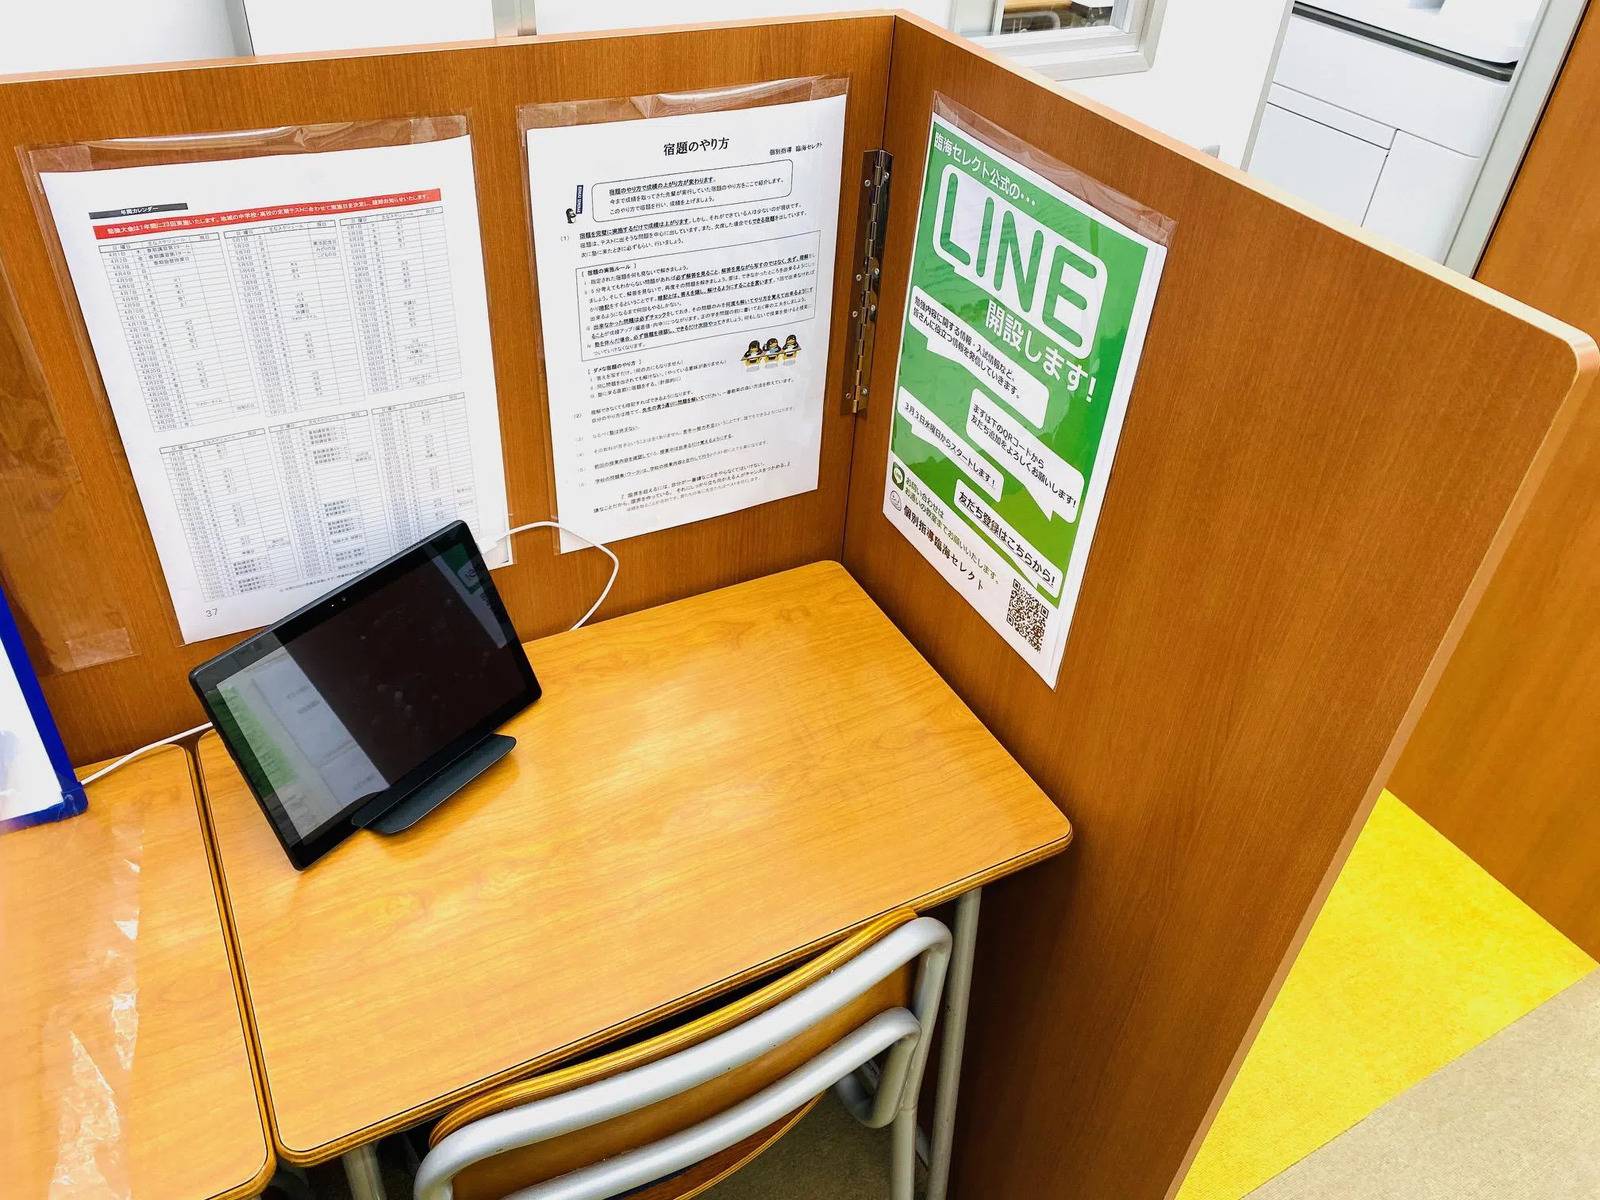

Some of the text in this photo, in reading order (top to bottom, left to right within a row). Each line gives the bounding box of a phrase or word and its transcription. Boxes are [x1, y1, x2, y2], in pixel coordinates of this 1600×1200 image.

[663, 136, 729, 156] 宿題のやり方
[795, 142, 822, 151] 臨海セレクト
[938, 170, 1099, 350] LINE
[913, 306, 1021, 400] 皆さんに役立つ情報を発信していきます。
[914, 294, 1016, 383] 勉強内容に関する情報・入試情報など、
[984, 299, 1097, 404] 開設します!
[970, 412, 1076, 510] 友だち追加をよろしくお願いします!
[903, 503, 984, 594] 個別指導臨海セレクト
[958, 489, 1055, 588] 友だち登録はこちらから!
[205, 608, 218, 617] 37
